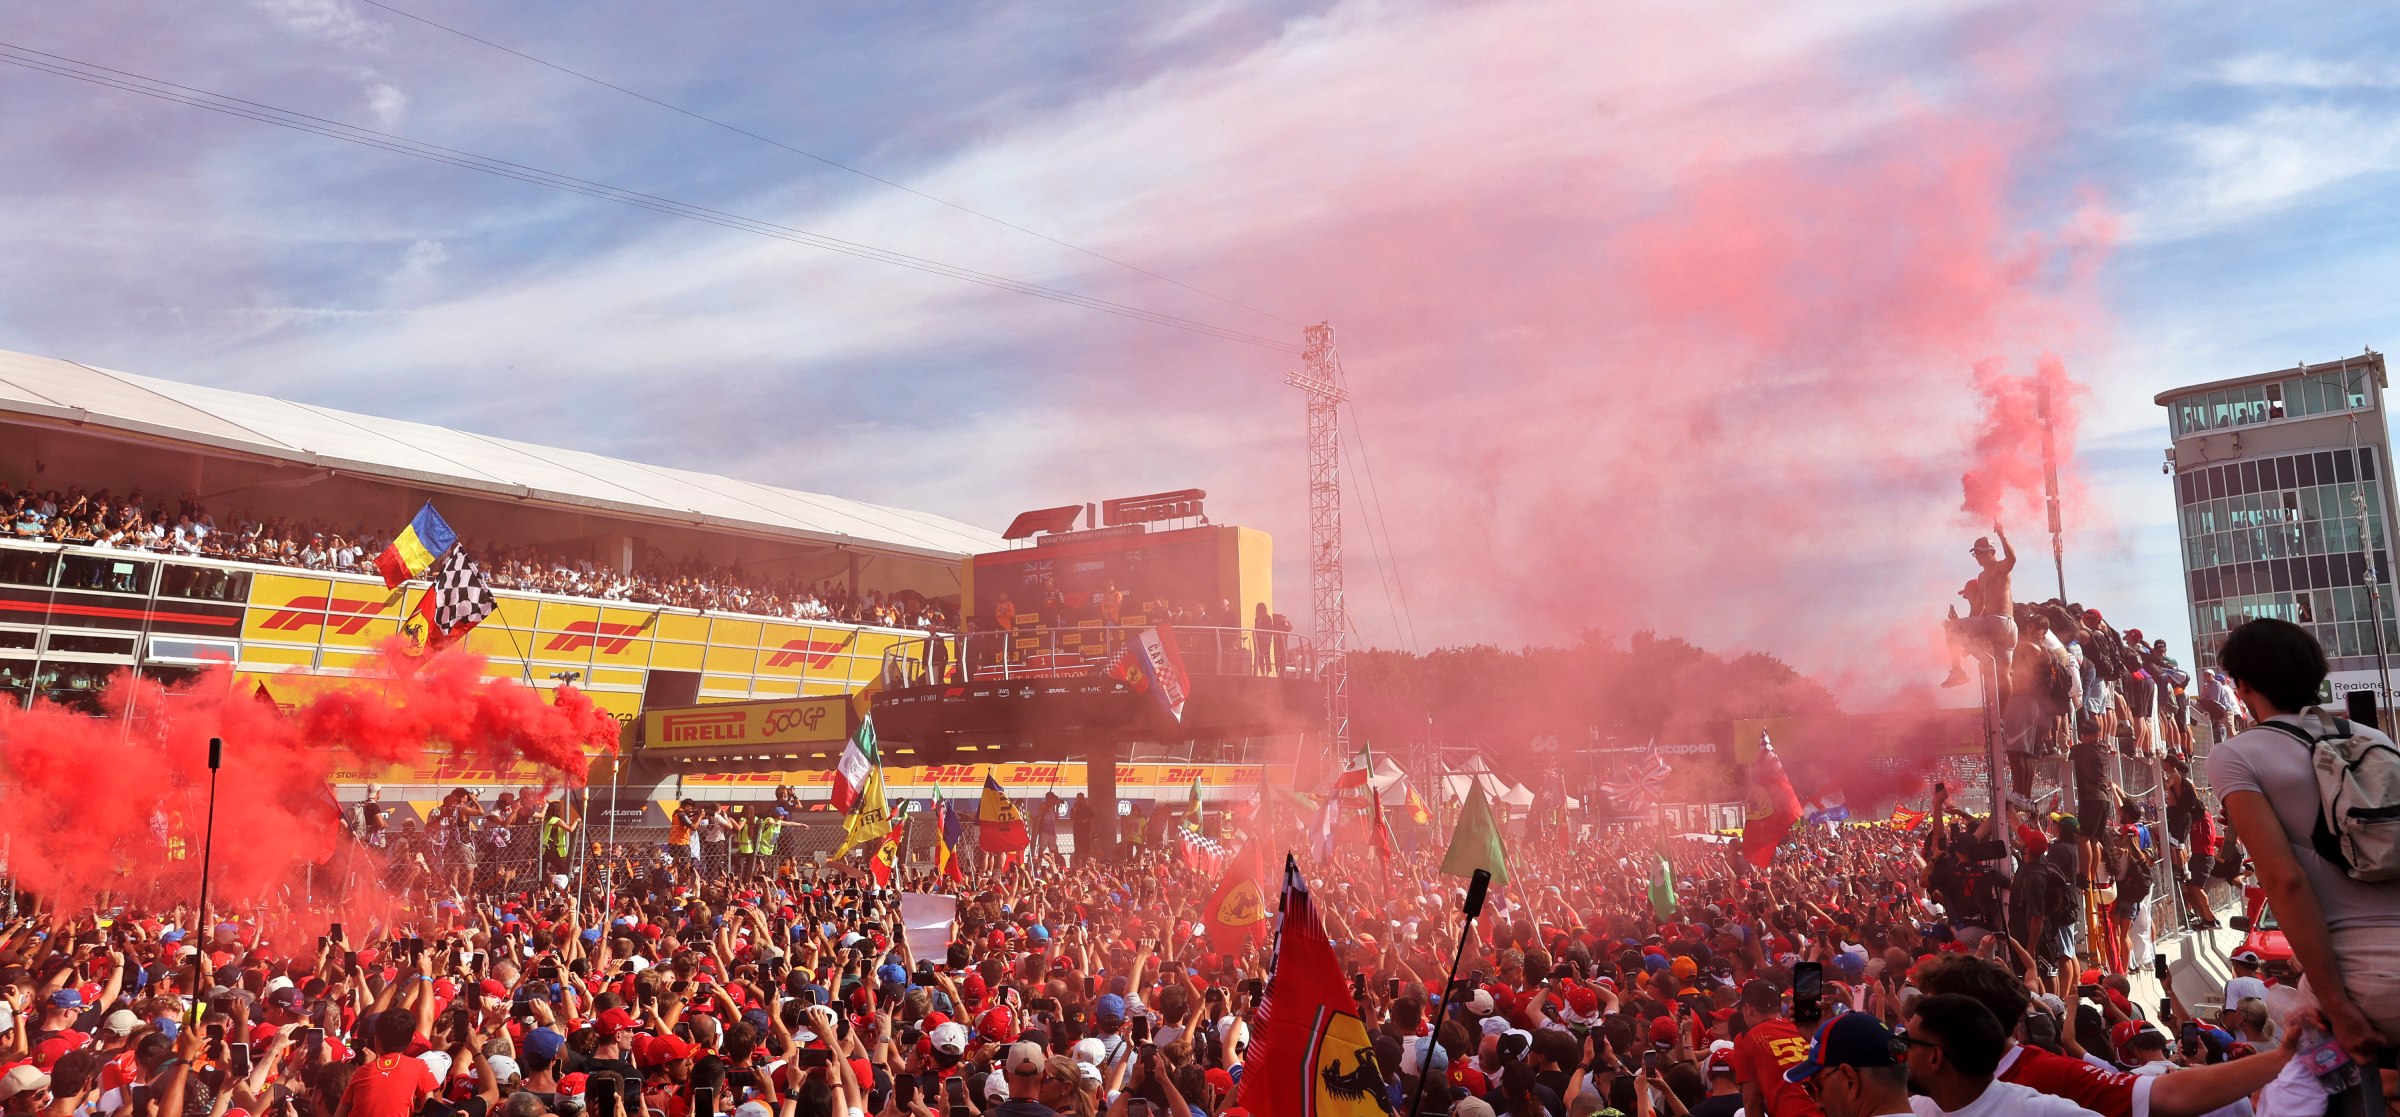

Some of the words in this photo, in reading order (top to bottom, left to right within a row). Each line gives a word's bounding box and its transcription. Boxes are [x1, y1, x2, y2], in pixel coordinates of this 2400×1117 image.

[1039, 536, 1058, 544] Global
[1059, 534, 1071, 543] Tyre
[1072, 532, 1093, 541] Partner
[1103, 529, 1127, 537] Formula
[259, 596, 390, 635] F1
[544, 621, 644, 654] F1
[766, 640, 846, 669] F1
[663, 711, 746, 742] PIRELLI
[336, 771, 358, 779] STOP
[922, 765, 975, 782] DHL
[1012, 766, 1059, 782] DHL
[1116, 768, 1136, 782] HL
[1167, 768, 1204, 782] DHL
[600, 809, 643, 817] McLaren
[1769, 1036, 1811, 1066] 55
